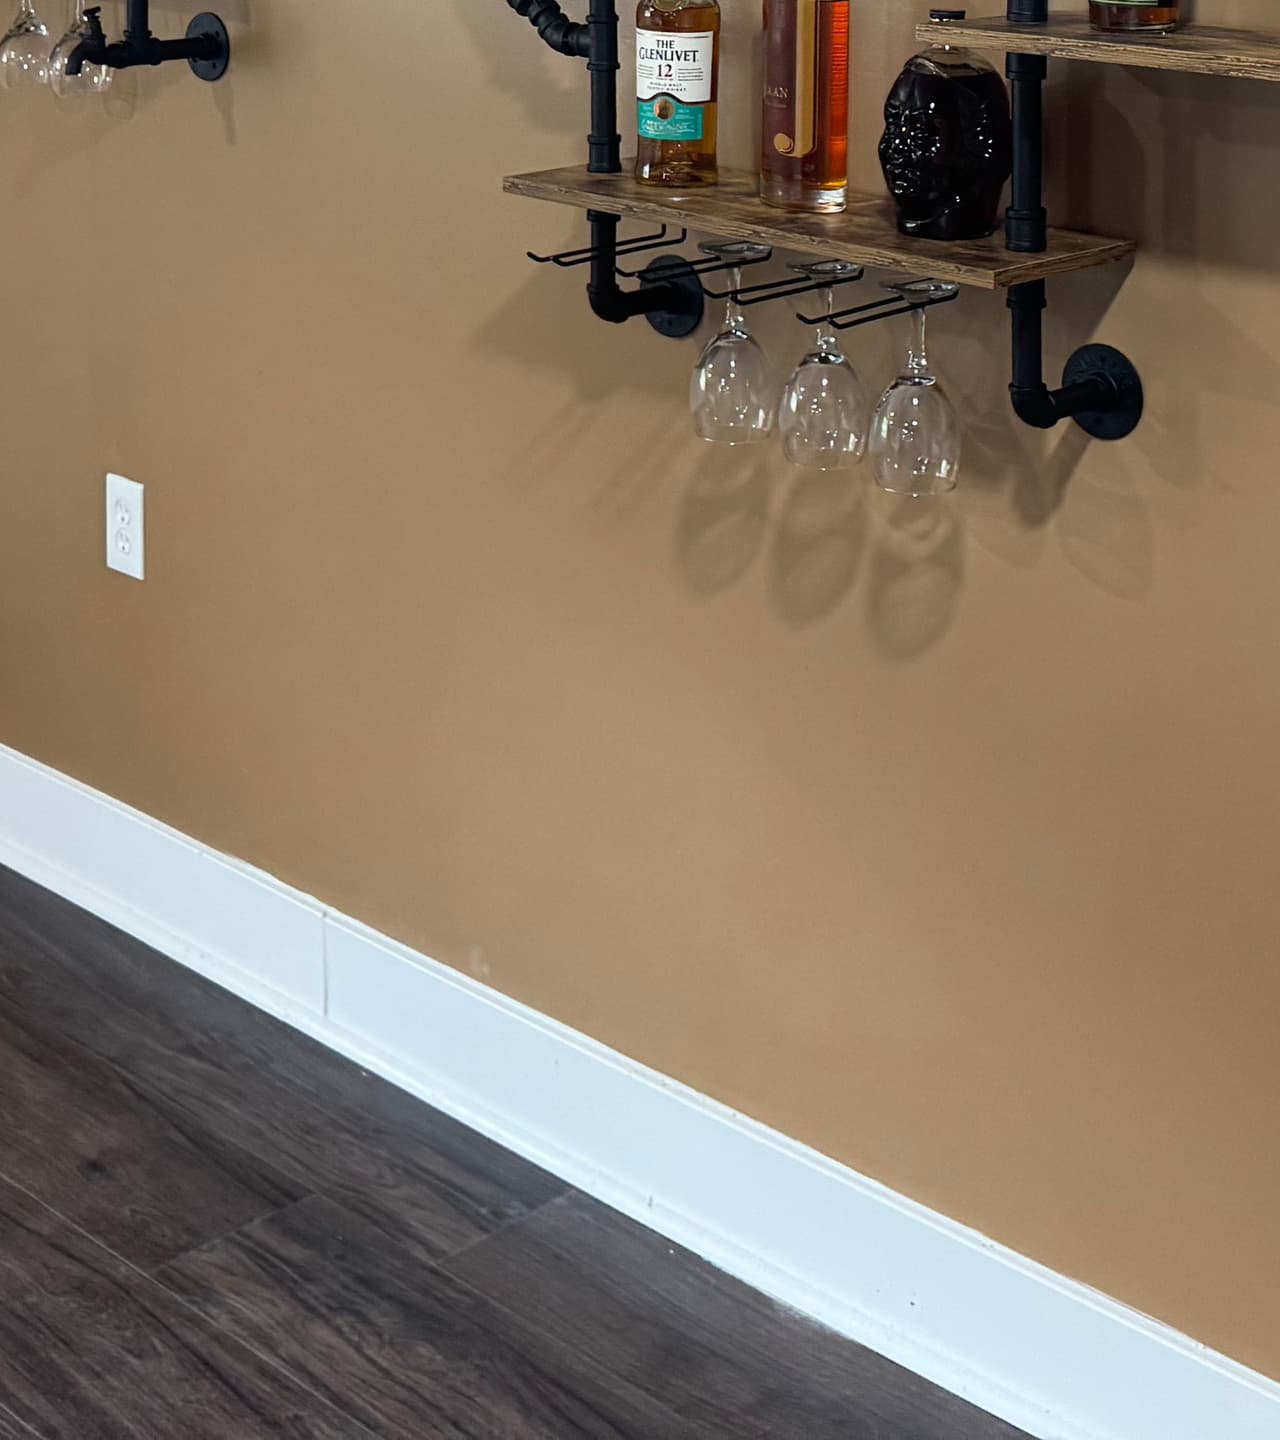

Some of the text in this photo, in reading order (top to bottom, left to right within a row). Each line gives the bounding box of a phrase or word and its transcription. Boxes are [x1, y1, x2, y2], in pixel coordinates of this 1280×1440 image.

[656, 39, 676, 49] THE
[639, 46, 699, 63] GLENLIVET
[657, 64, 673, 78] 12
